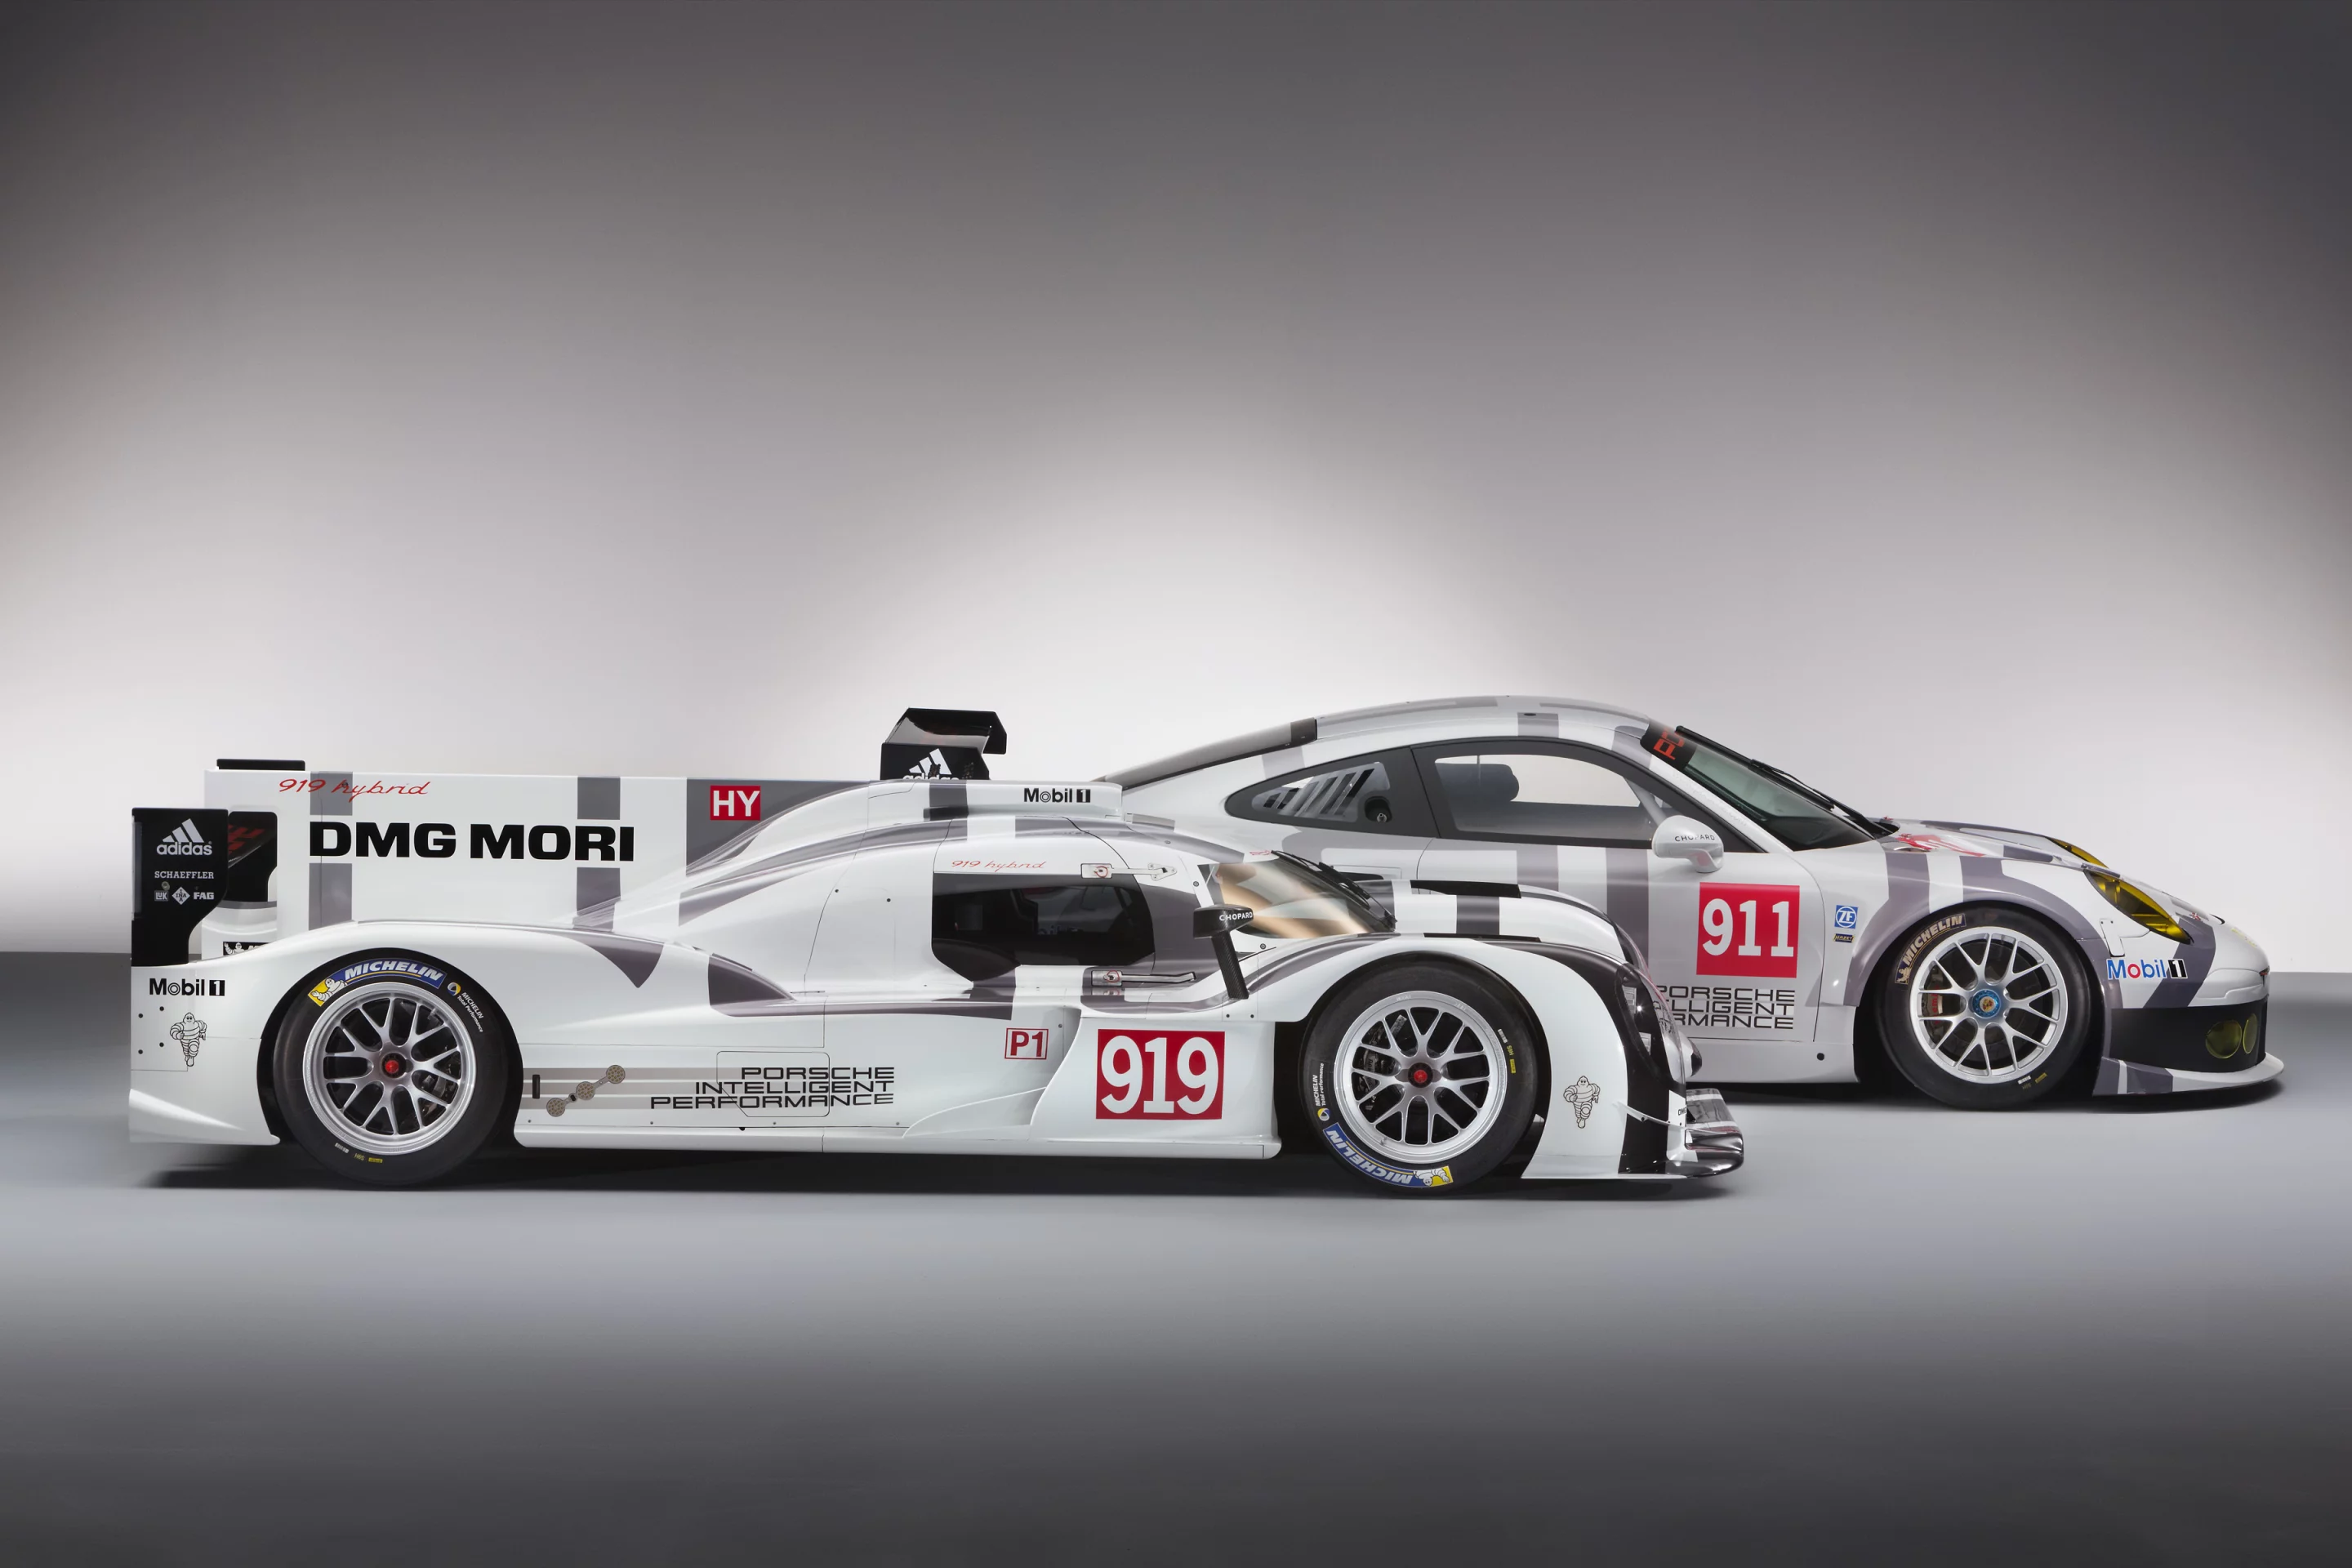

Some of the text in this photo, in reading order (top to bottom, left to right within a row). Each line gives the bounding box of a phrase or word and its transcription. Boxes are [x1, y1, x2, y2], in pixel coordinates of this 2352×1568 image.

[278, 778, 431, 802] 919 hybrid
[1023, 787, 1072, 803] Mobil
[713, 790, 760, 817] HY
[156, 841, 212, 855] adidas
[309, 821, 457, 858] DMG
[470, 823, 635, 862] MORI
[154, 871, 214, 880] SCHAEFFLER
[984, 861, 1047, 872] hybrid
[194, 892, 215, 900] FAG
[1219, 911, 1253, 921] CHOPARD
[1702, 898, 1794, 957] 911
[1902, 915, 1962, 966] MICHELIN
[345, 960, 443, 981] MICHELIN
[2106, 959, 2185, 979] Mobil 1
[149, 978, 205, 996] Mobil
[457, 996, 483, 1032] Total Performance
[461, 991, 484, 1019] MICHELIN
[1666, 999, 1794, 1015] LLIGENT
[1009, 1031, 1044, 1057] P1
[741, 1067, 894, 1080] PORSCHE
[1101, 1035, 1219, 1115] 919
[696, 1080, 894, 1094] INTELLIGENT
[1312, 1074, 1321, 1107] MICHELIN
[651, 1093, 894, 1109] PERFORMANCE
[1325, 1129, 1414, 1184] MICHELIN
